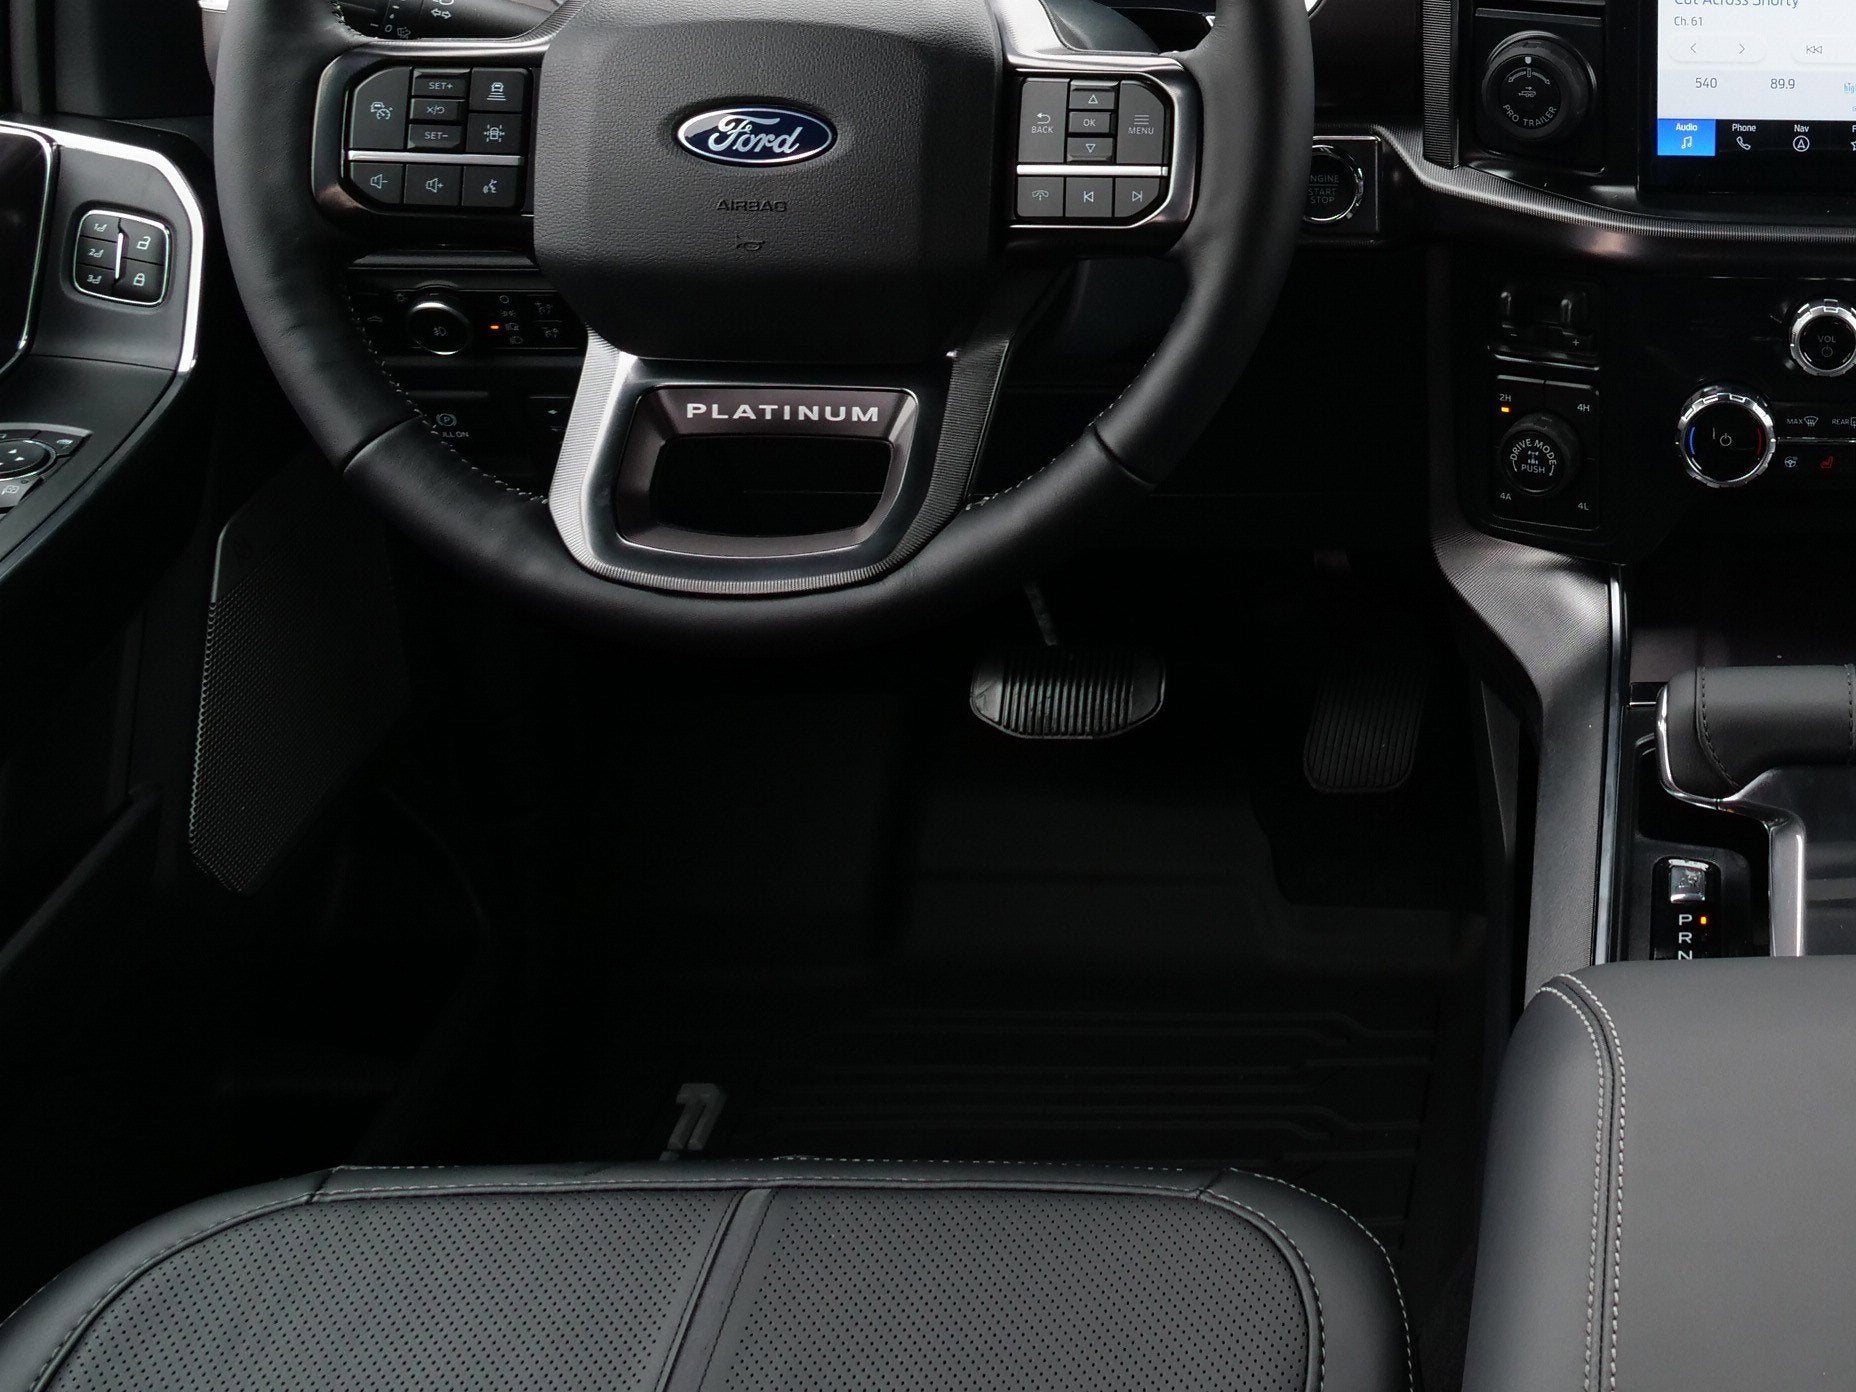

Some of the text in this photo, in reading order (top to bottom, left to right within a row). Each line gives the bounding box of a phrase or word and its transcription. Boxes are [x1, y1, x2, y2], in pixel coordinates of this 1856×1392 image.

[1673, 15, 1704, 27] Ch. 61
[428, 81, 454, 90] SET+
[1694, 77, 1718, 90] 540
[1769, 78, 1796, 90] 89.9
[1082, 118, 1096, 127] OK
[1675, 122, 1698, 133] Audio
[707, 113, 804, 154] Ford
[1031, 126, 1054, 134] BACK
[1127, 127, 1155, 135] MENU
[1732, 123, 1757, 134] Phone
[1793, 124, 1810, 134] Nav
[716, 199, 788, 213] AIRBAG
[1817, 335, 1837, 344] VOL
[1499, 393, 1512, 402] 2H
[686, 403, 879, 422] PLATINUM
[1577, 403, 1590, 412] 4H
[1831, 418, 1850, 426] REAR
[1510, 438, 1557, 466] DRIVE MODE
[1521, 464, 1546, 474] PUSH
[1499, 492, 1512, 501] 4A
[1577, 502, 1590, 511] 4L
[1678, 913, 1693, 926] P
[1678, 931, 1693, 944] R
[1677, 949, 1693, 960] N
